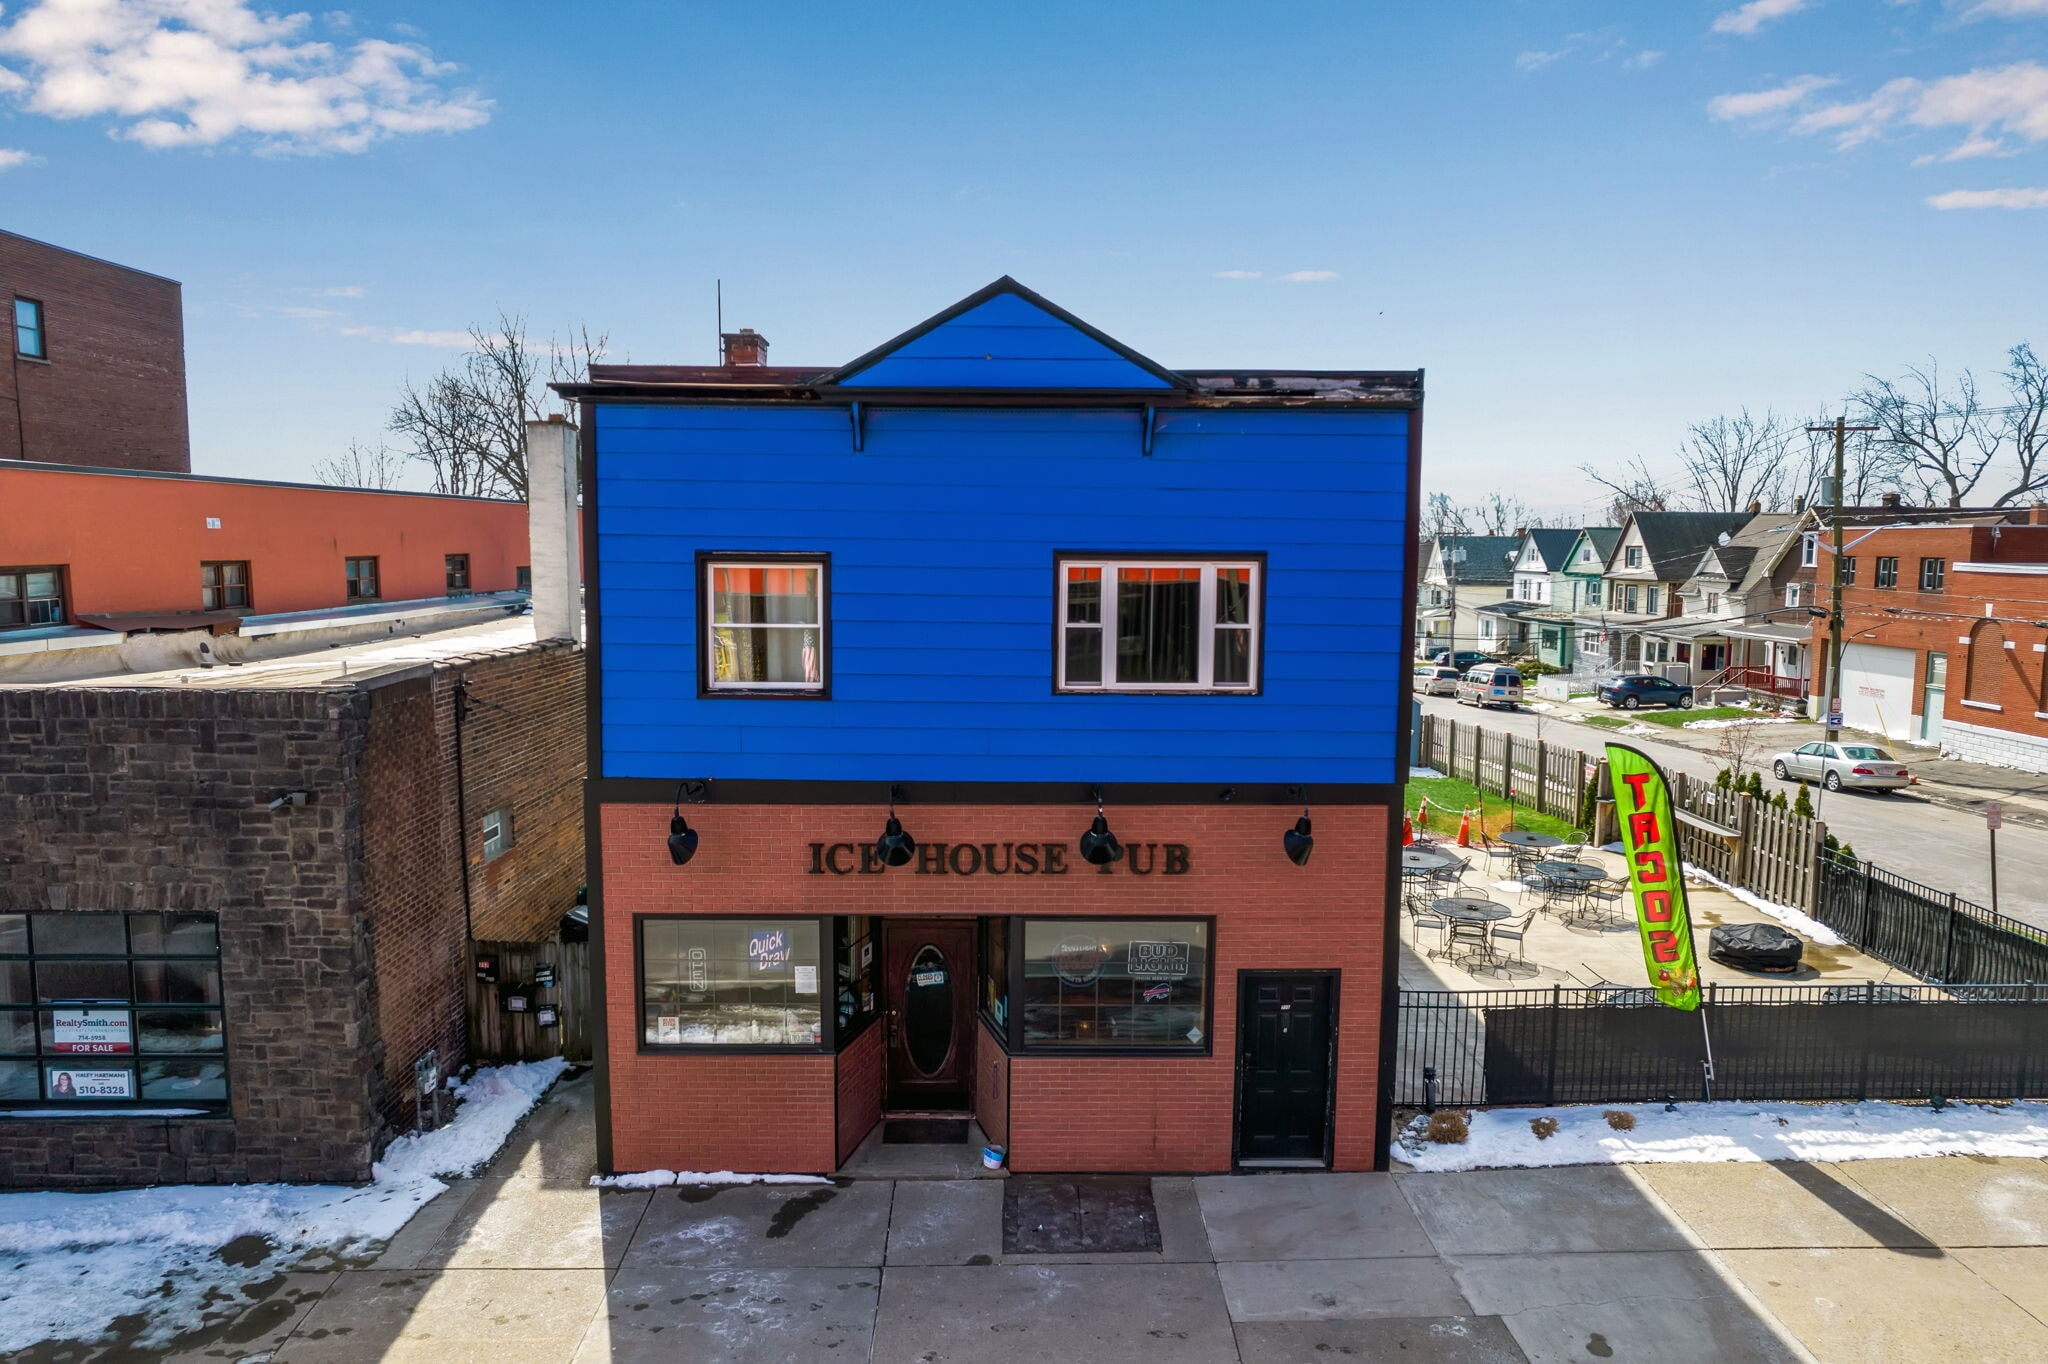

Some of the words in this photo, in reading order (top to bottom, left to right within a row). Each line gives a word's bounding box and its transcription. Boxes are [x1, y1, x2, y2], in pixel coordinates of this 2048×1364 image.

[808, 843, 885, 875] ICE
[914, 843, 1068, 876] HOUSE
[749, 930, 783, 957] Quick
[1139, 944, 1178, 958] BUD
[1130, 957, 1186, 972] LIGHT
[56, 1019, 128, 1029] RealtySmith.com
[72, 1044, 90, 1052] FOR
[92, 1044, 114, 1052] SALE
[79, 1086, 125, 1095] 510-8328
